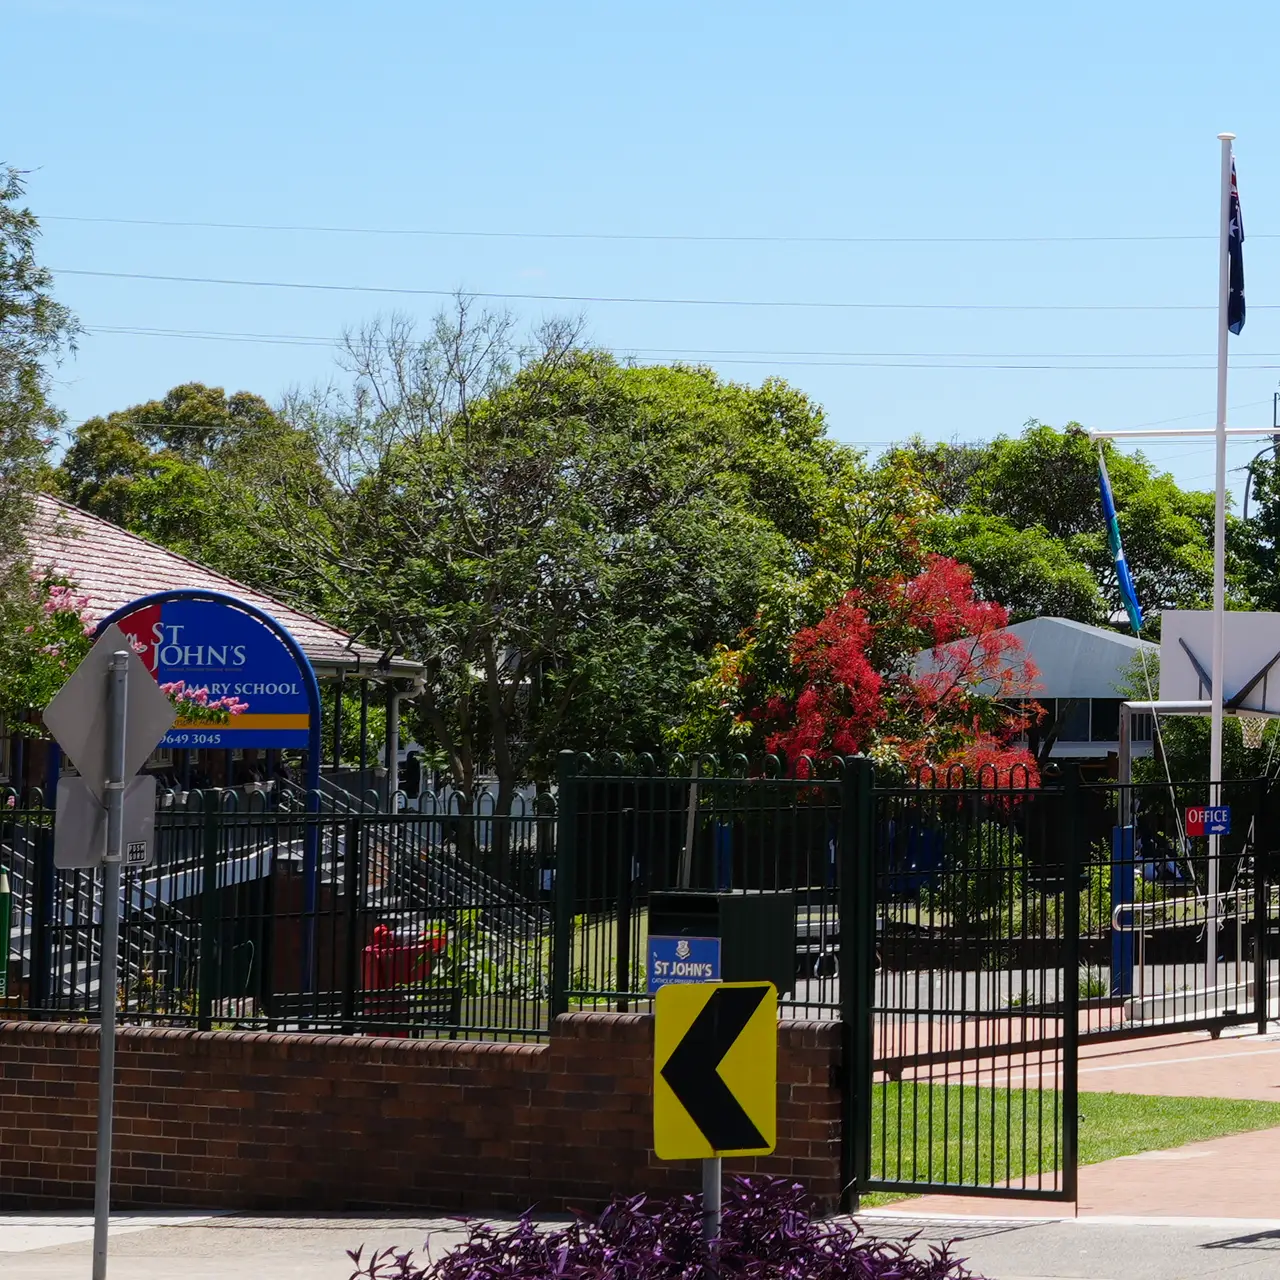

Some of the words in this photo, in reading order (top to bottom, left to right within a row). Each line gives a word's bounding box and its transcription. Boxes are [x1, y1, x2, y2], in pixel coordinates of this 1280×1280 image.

[151, 622, 184, 646] ST
[149, 644, 246, 672] JOHN'S
[233, 682, 300, 695] SCHOOL
[191, 734, 221, 744] 3045
[1188, 809, 1228, 823] OFFICE
[654, 960, 670, 975] ST
[670, 961, 712, 977] JOHN'S
